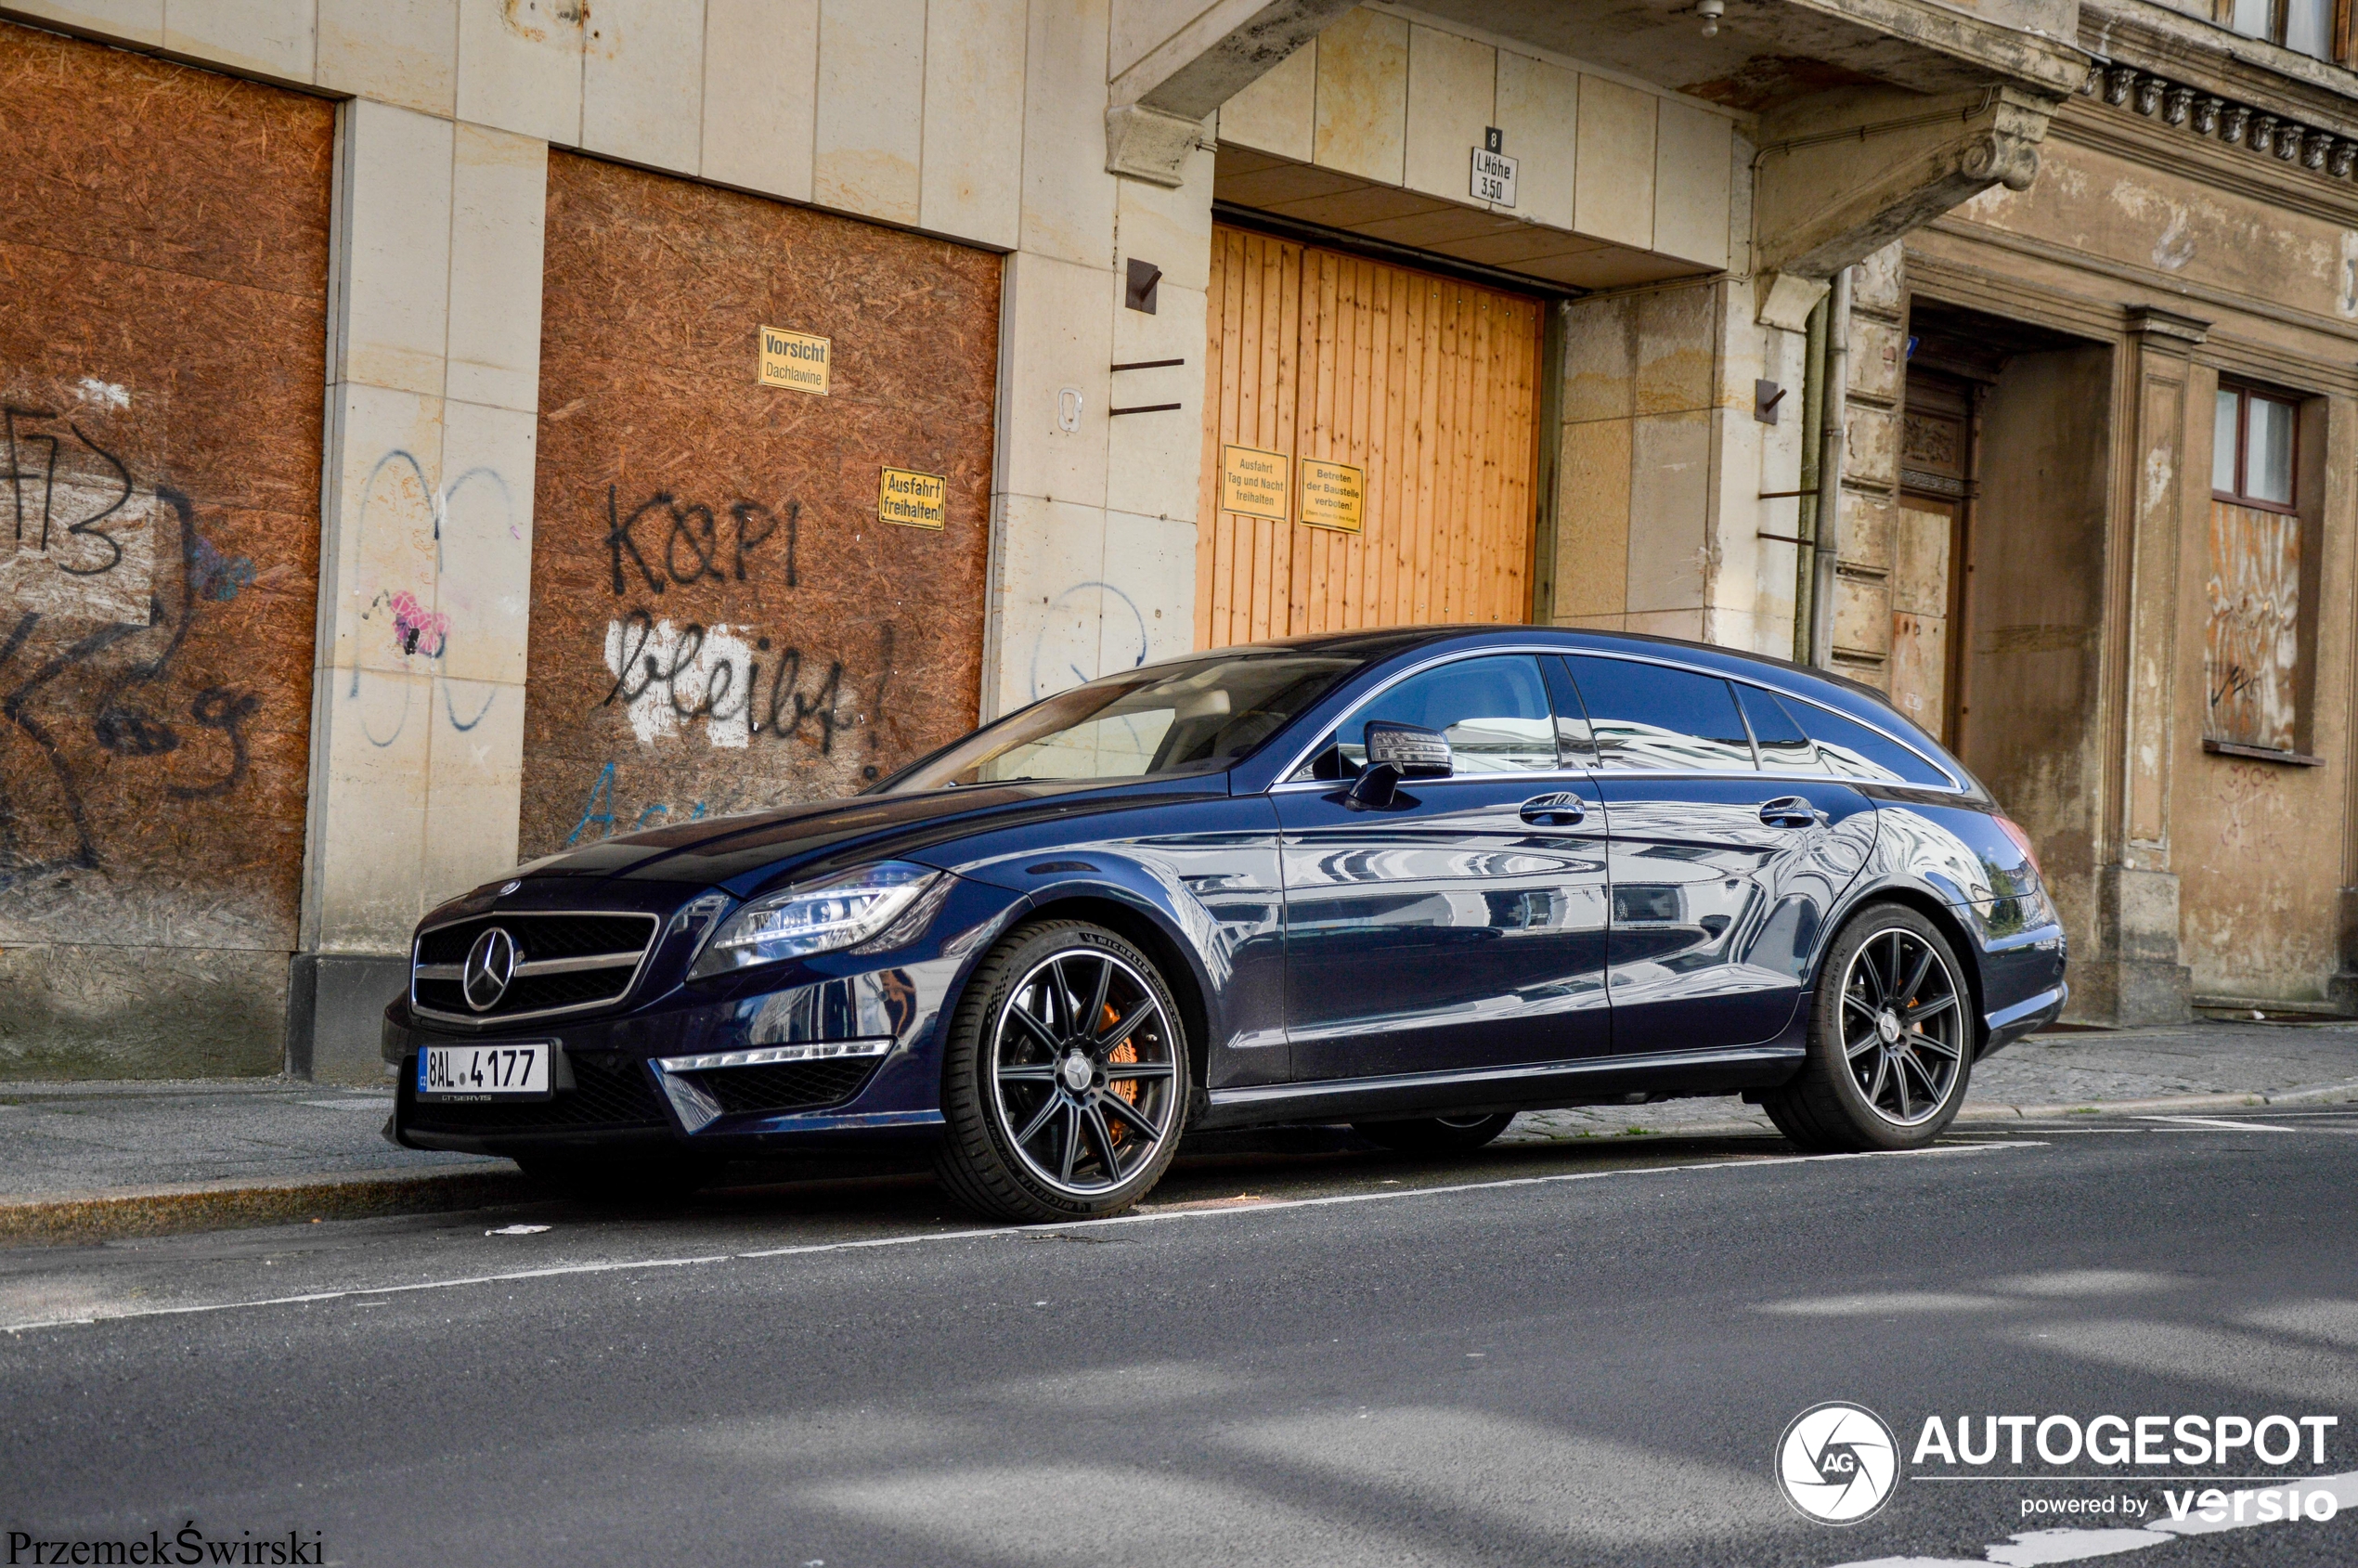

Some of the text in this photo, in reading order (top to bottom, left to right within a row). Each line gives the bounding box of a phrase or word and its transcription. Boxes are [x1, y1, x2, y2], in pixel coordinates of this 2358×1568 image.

[1490, 133, 1497, 148] 8
[1482, 176, 1502, 200] 3,50
[766, 334, 825, 363] Vorsicht
[766, 361, 822, 385] Dachlawine
[1239, 459, 1273, 474] Ausfahrt
[1316, 469, 1352, 484] Betreten
[887, 473, 940, 499] Ausfahrt
[1227, 472, 1284, 492] Tag und Nacht
[1306, 481, 1359, 499] der Baustelle
[884, 496, 941, 522] freihalten!
[1237, 490, 1275, 506] freihalten
[1315, 497, 1353, 512] verboten!
[1097, 936, 1149, 974] MICHELIN
[429, 1049, 536, 1087] 8AL 4177
[420, 1075, 427, 1086] CZ
[1017, 1173, 1075, 1211] MICHELIN
